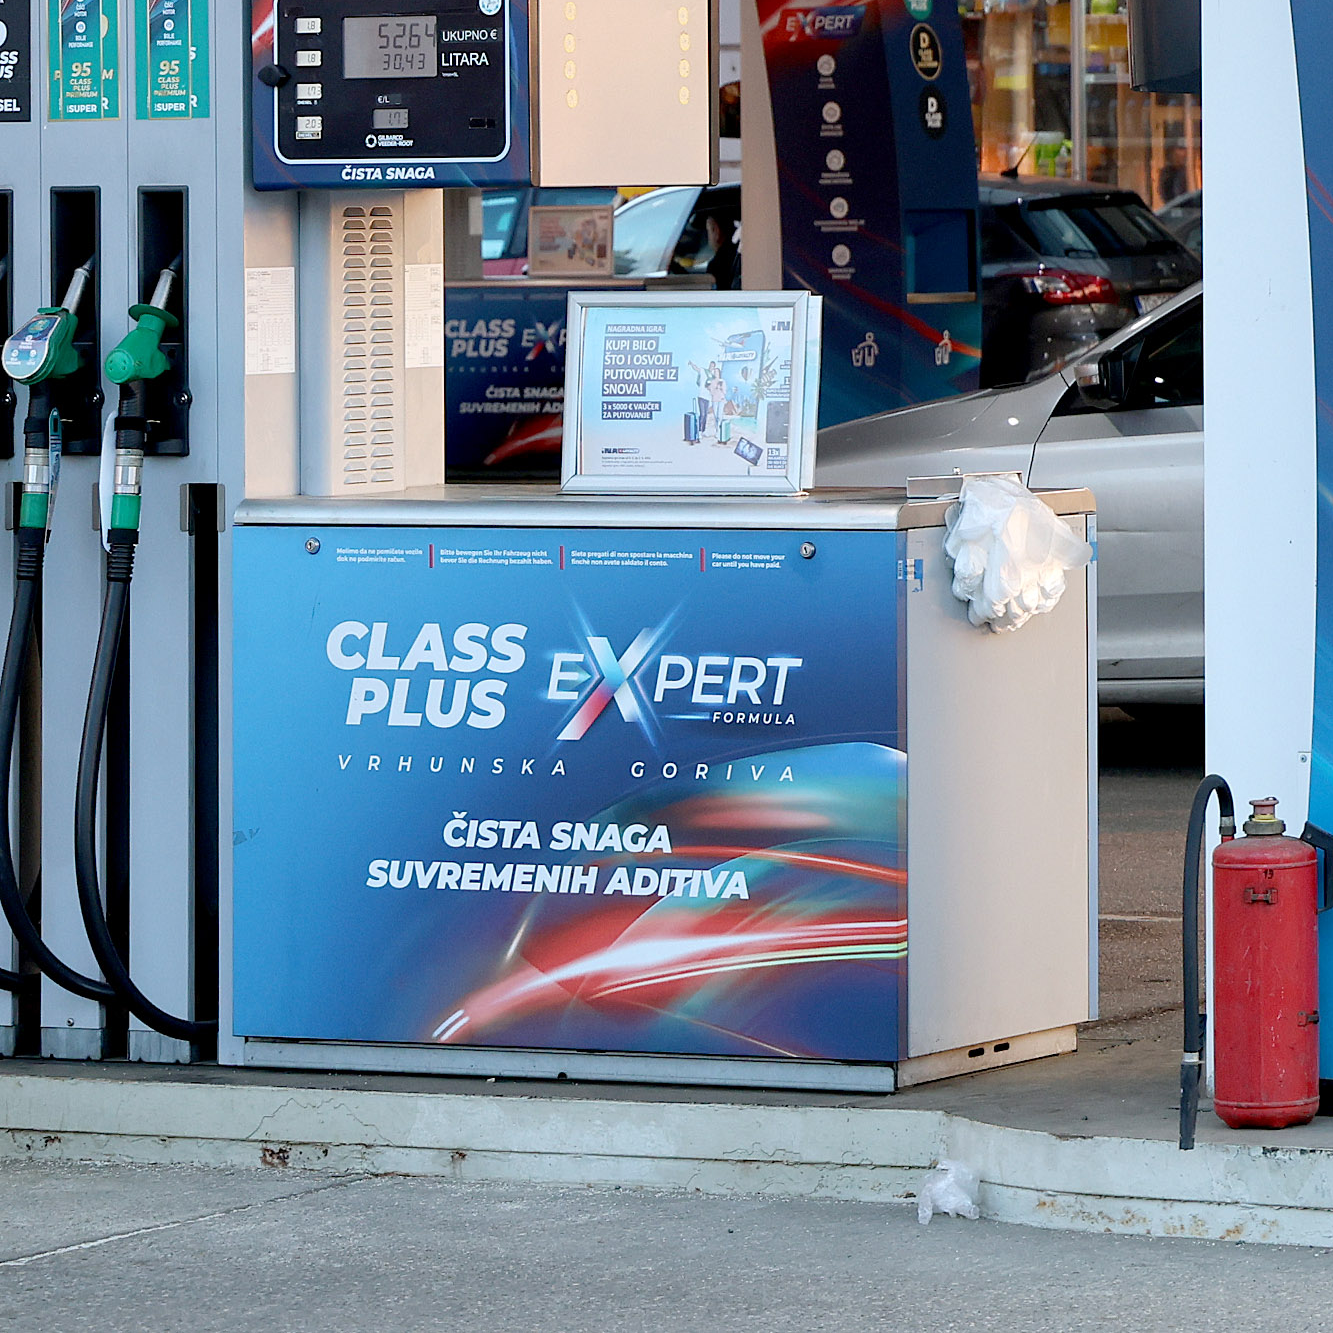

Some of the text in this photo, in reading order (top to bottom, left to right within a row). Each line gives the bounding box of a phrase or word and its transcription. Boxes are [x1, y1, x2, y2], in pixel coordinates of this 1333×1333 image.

[442, 30, 488, 41] UKUPNO
[920, 32, 929, 48] D
[383, 54, 425, 71] 30,43
[441, 53, 489, 66] LITARA
[71, 62, 91, 77] 95
[159, 60, 179, 75] 95
[154, 89, 186, 97] PREMIUM
[69, 104, 97, 113] SUPER
[157, 103, 185, 111] SUPER
[928, 97, 937, 112] D
[342, 165, 435, 180] ČISTA SNAGA
[445, 318, 516, 338] CLASS
[452, 339, 509, 358] PLUS
[605, 340, 656, 350] KUPI BILO
[605, 352, 670, 365] ŠTO I OSVOJI
[604, 369, 677, 380] PUTOVANJE IZ
[603, 384, 642, 394] SNOVA!
[634, 401, 659, 410] VAUČER
[326, 620, 527, 673] CLASS
[548, 627, 802, 741] EXPERT
[345, 677, 507, 730] PLUS
[712, 711, 796, 726] FORMULA
[338, 755, 795, 782] VRHUNSKA GORIVA
[444, 811, 673, 854] ČISTA SNAGA
[366, 861, 751, 901] SUVREMENIH ADITIVA
